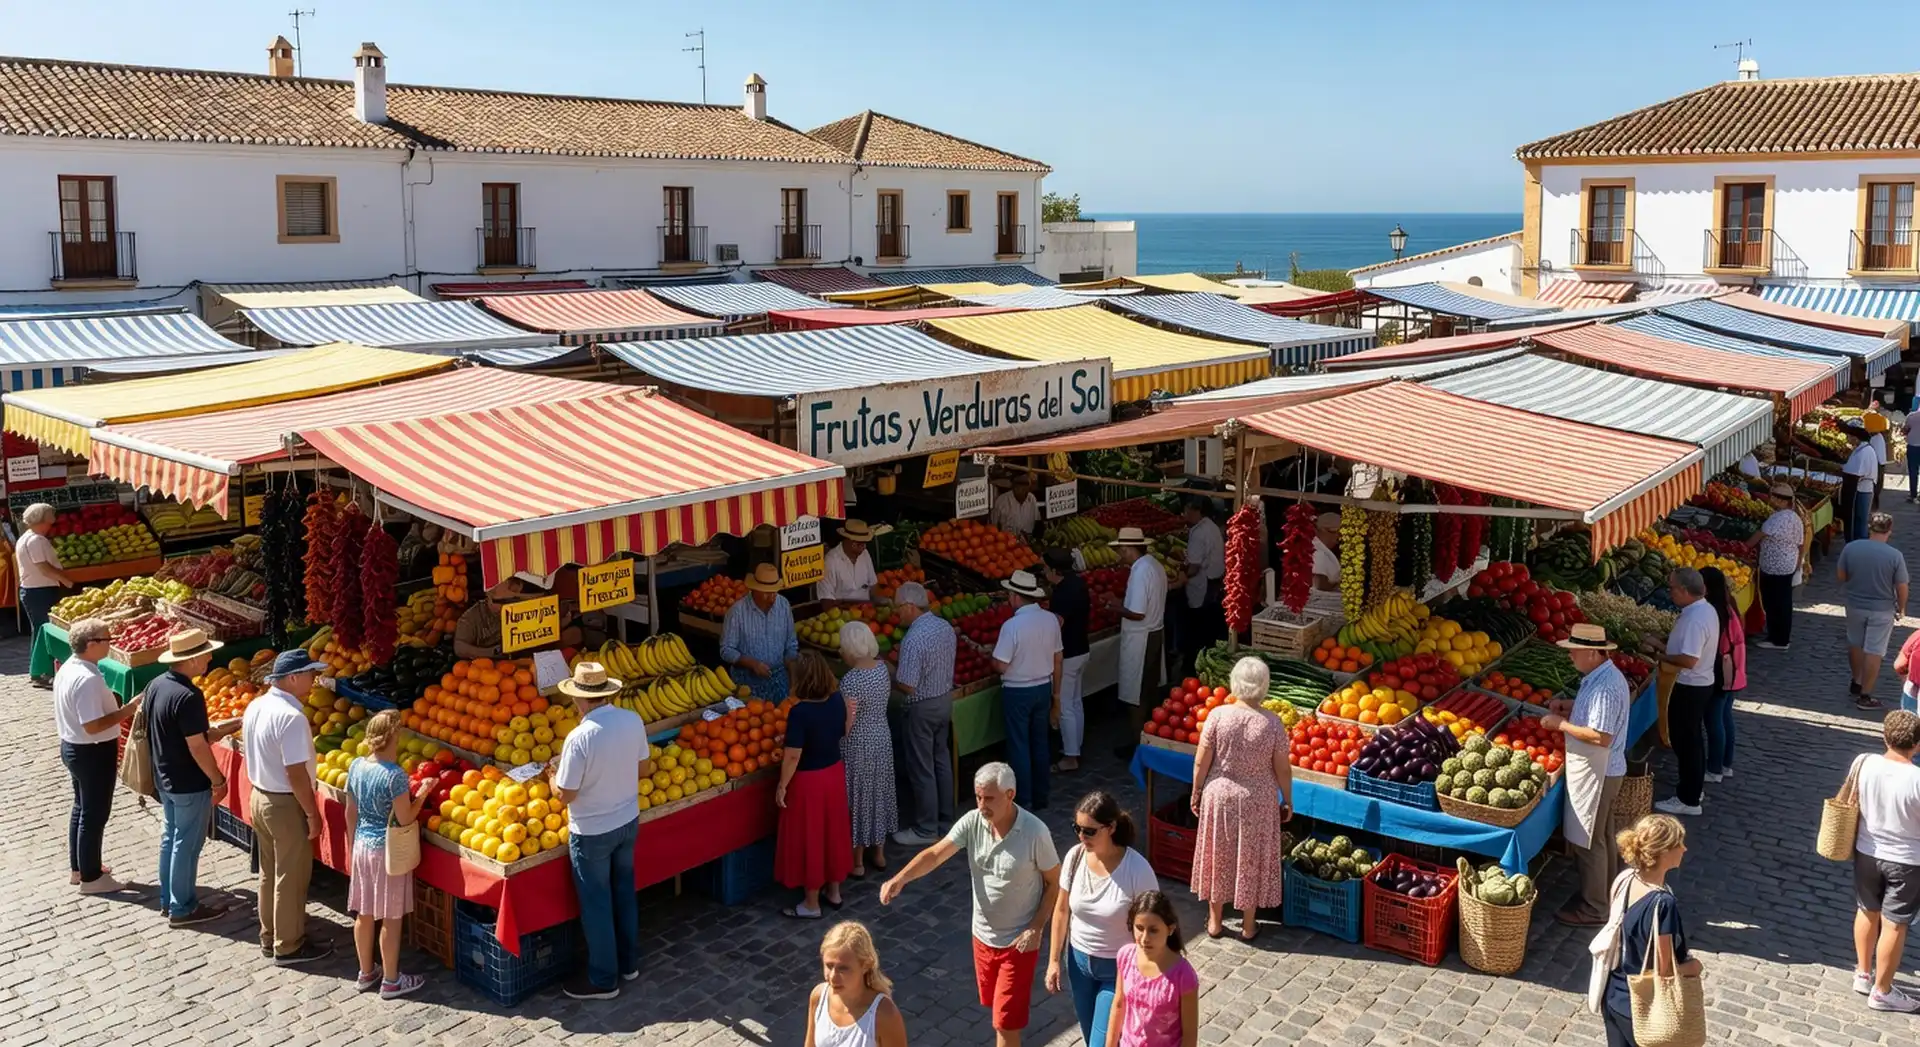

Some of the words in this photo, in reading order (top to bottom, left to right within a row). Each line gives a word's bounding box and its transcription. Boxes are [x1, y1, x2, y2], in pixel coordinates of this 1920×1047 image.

[810, 397, 901, 457] Frutas
[907, 418, 921, 451] y
[923, 381, 1032, 437] Verduras
[1037, 376, 1063, 420] del
[1070, 366, 1106, 415] Sol
